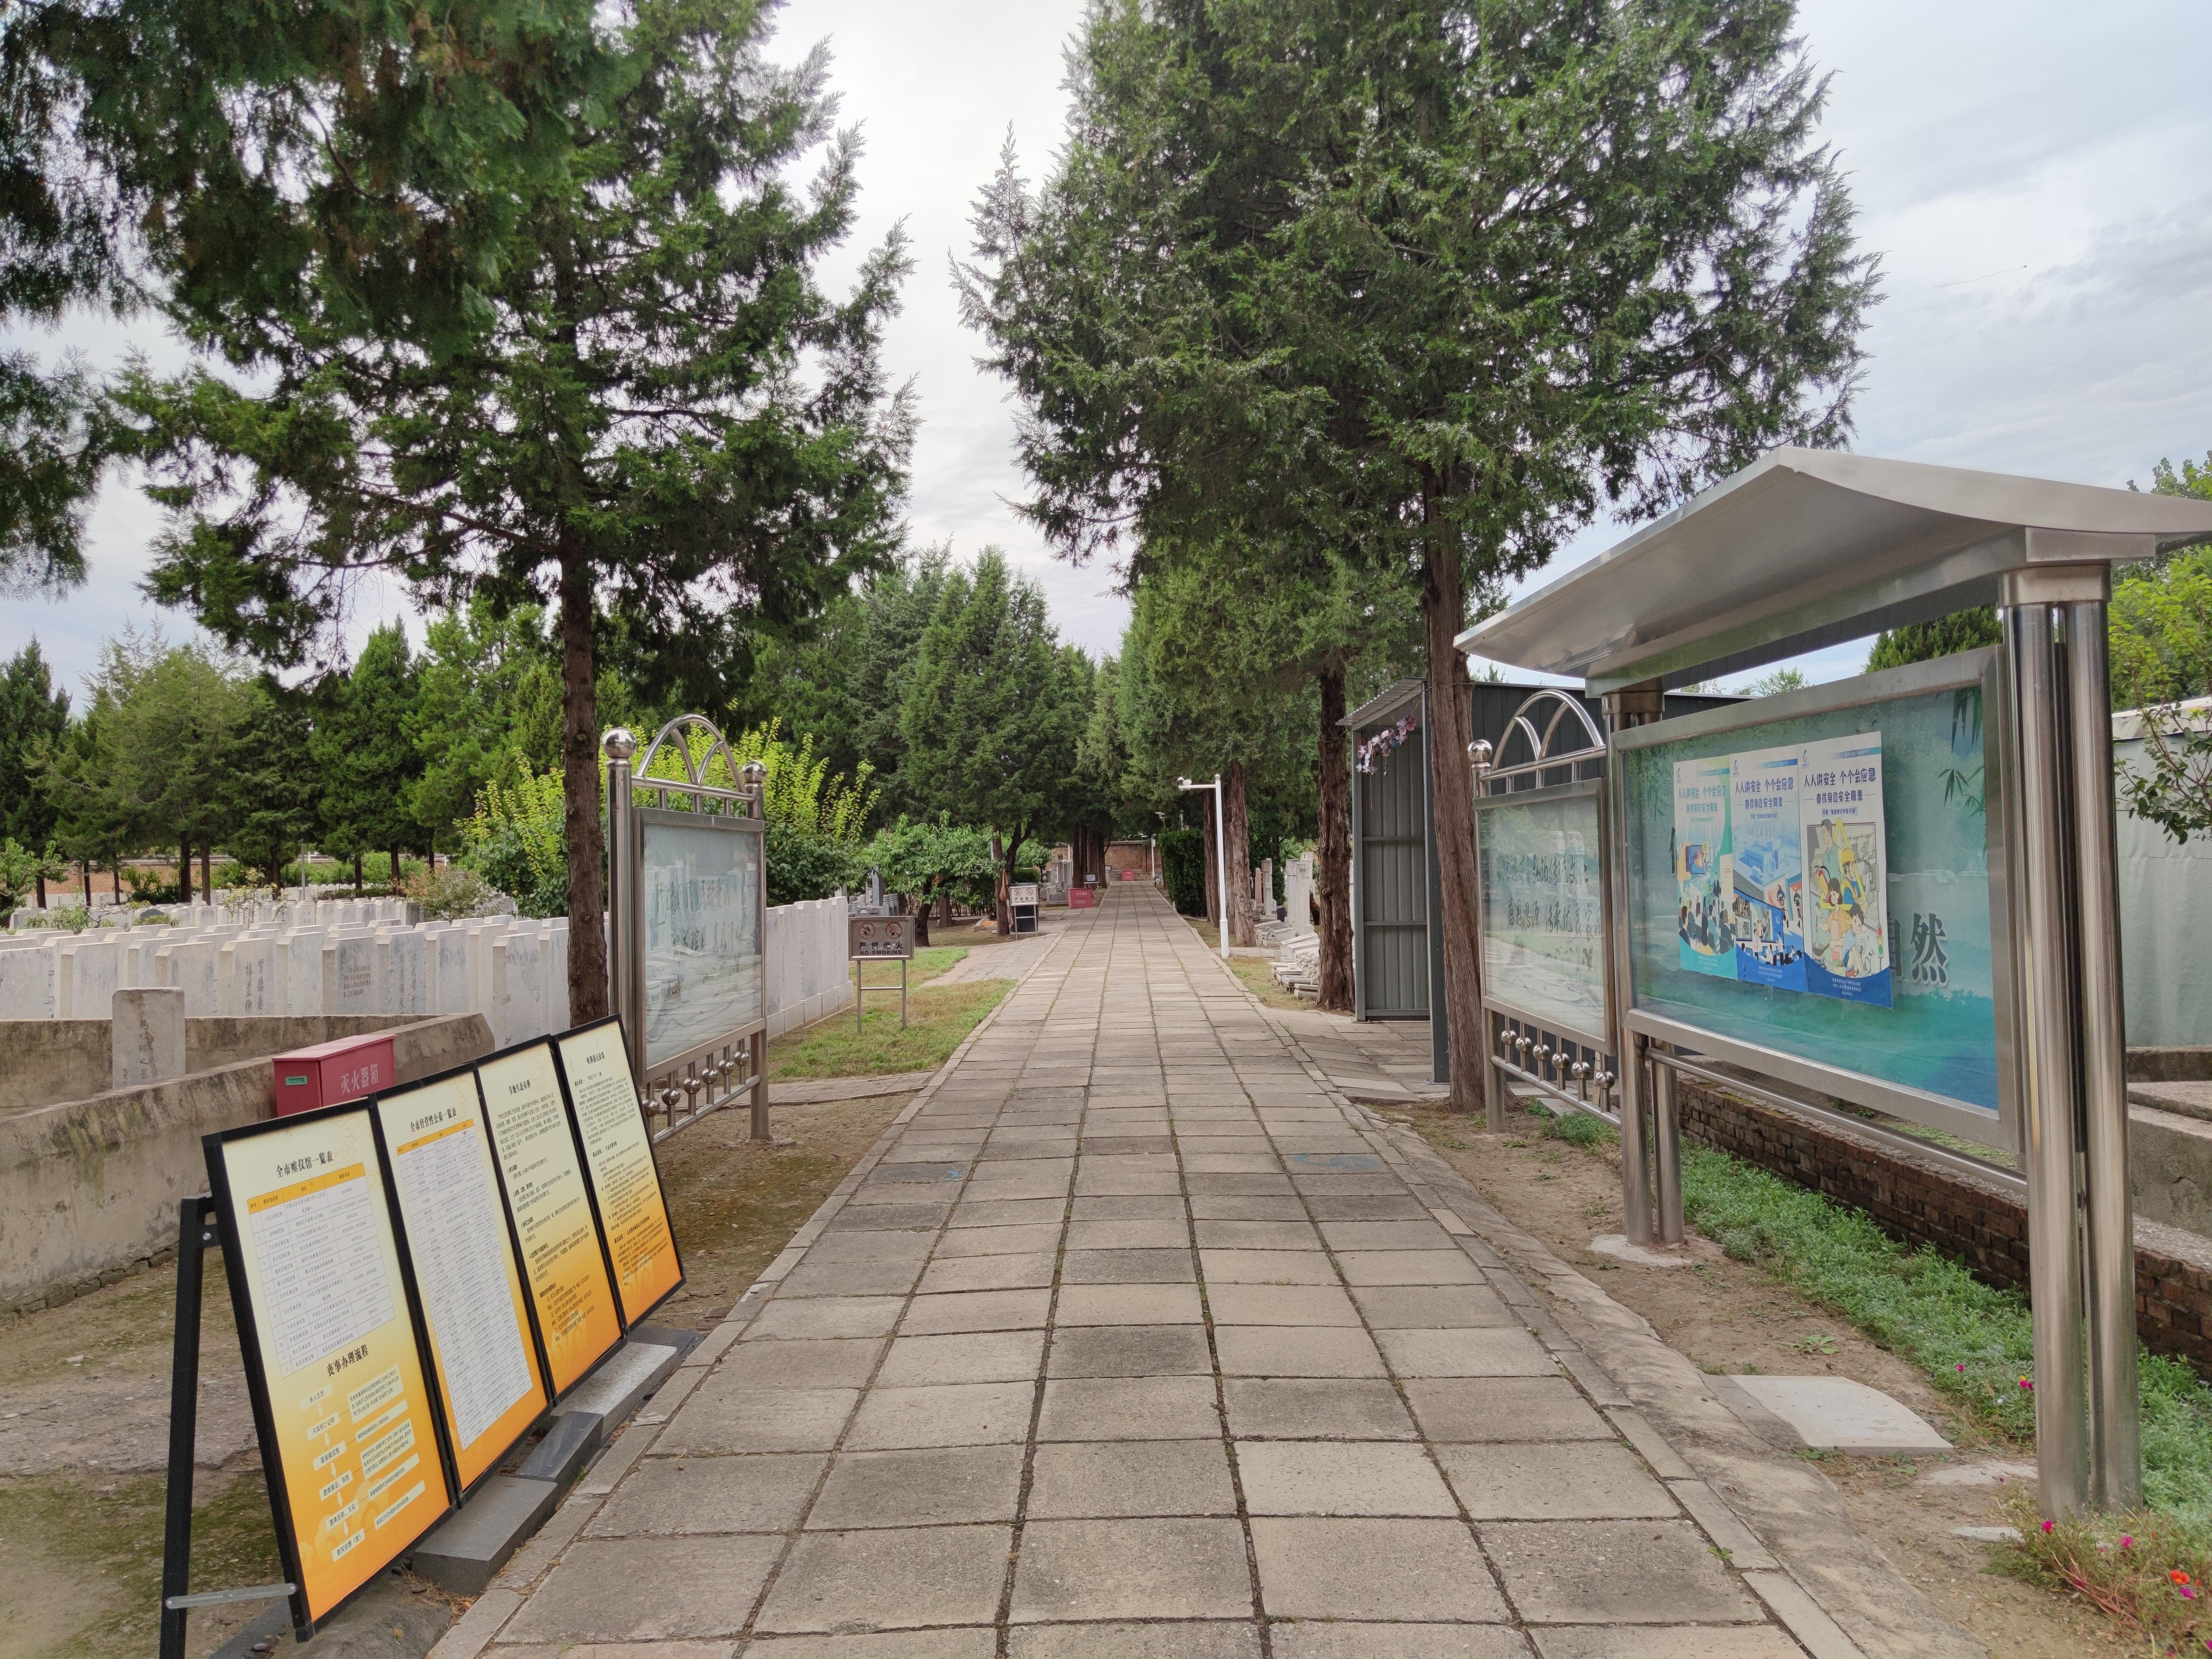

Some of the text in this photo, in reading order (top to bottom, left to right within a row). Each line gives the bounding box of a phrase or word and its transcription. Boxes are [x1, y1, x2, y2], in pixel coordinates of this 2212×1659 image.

[1735, 777, 1793, 794] 人人讲安全 个个会应急
[1804, 767, 1876, 788] 人人讲安全 个个会应急
[1678, 785, 1727, 799] 人人讲安全 个个会应急
[1816, 790, 1863, 804] 查找身边安全隐患
[1745, 797, 1783, 809] 查找身边安全隐患
[859, 941, 902, 949] 严禁烟火
[586, 1051, 605, 1066] 殡葬惠民政策
[341, 1063, 378, 1095] 灭火器箱
[508, 1078, 531, 1096] 节地生态安葬
[409, 1105, 457, 1133] 全市经营性公墓一览表
[275, 1149, 334, 1179] 全市殡仪馆一览表
[326, 1342, 369, 1378] 丧事办理流程
[309, 1389, 324, 1404] 亲人去世
[312, 1416, 335, 1436] 开具死亡证明
[320, 1446, 340, 1465] 联系殡仪馆
[323, 1473, 350, 1498] 遗体接运、存放
[329, 1502, 356, 1528] 遗体告别、火化
